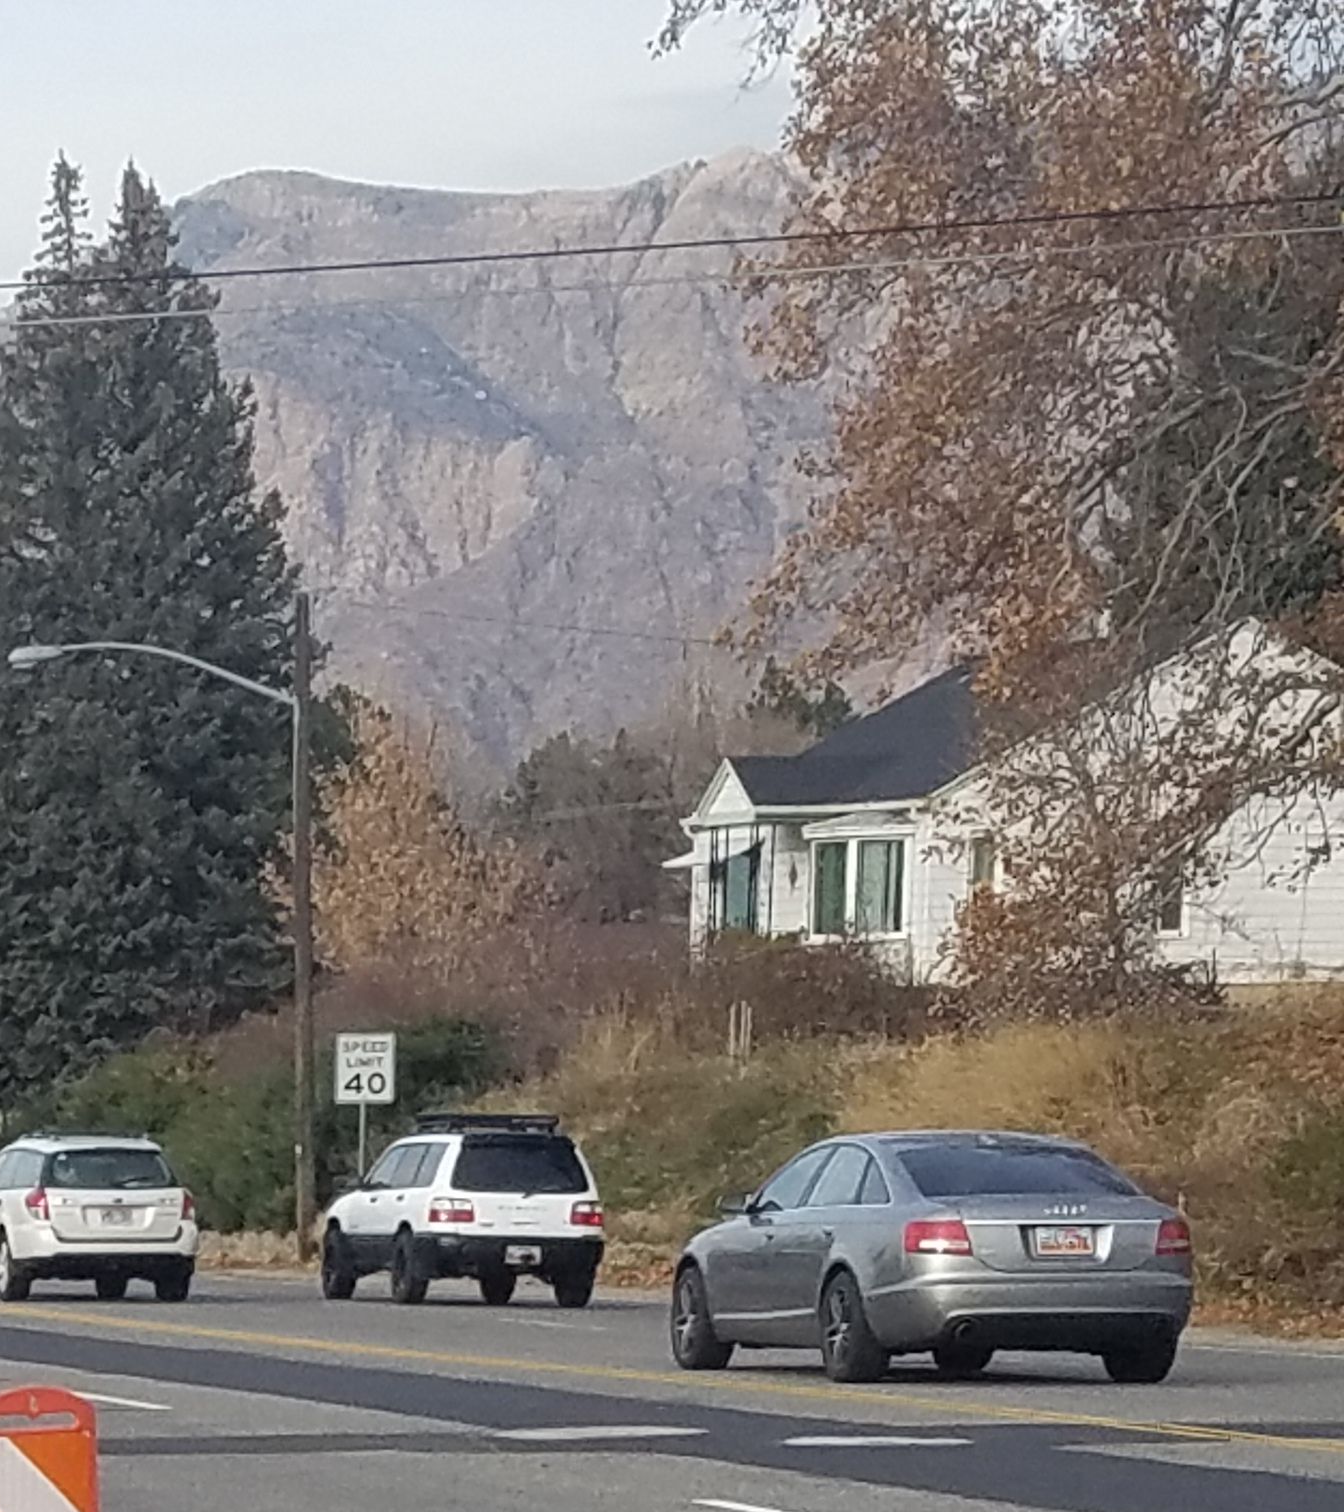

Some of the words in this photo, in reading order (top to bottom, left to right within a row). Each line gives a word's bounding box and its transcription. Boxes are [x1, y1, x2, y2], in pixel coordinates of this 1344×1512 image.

[342, 1041, 389, 1053] SPEED
[346, 1056, 384, 1068] LIMIT
[343, 1072, 386, 1094] 40
